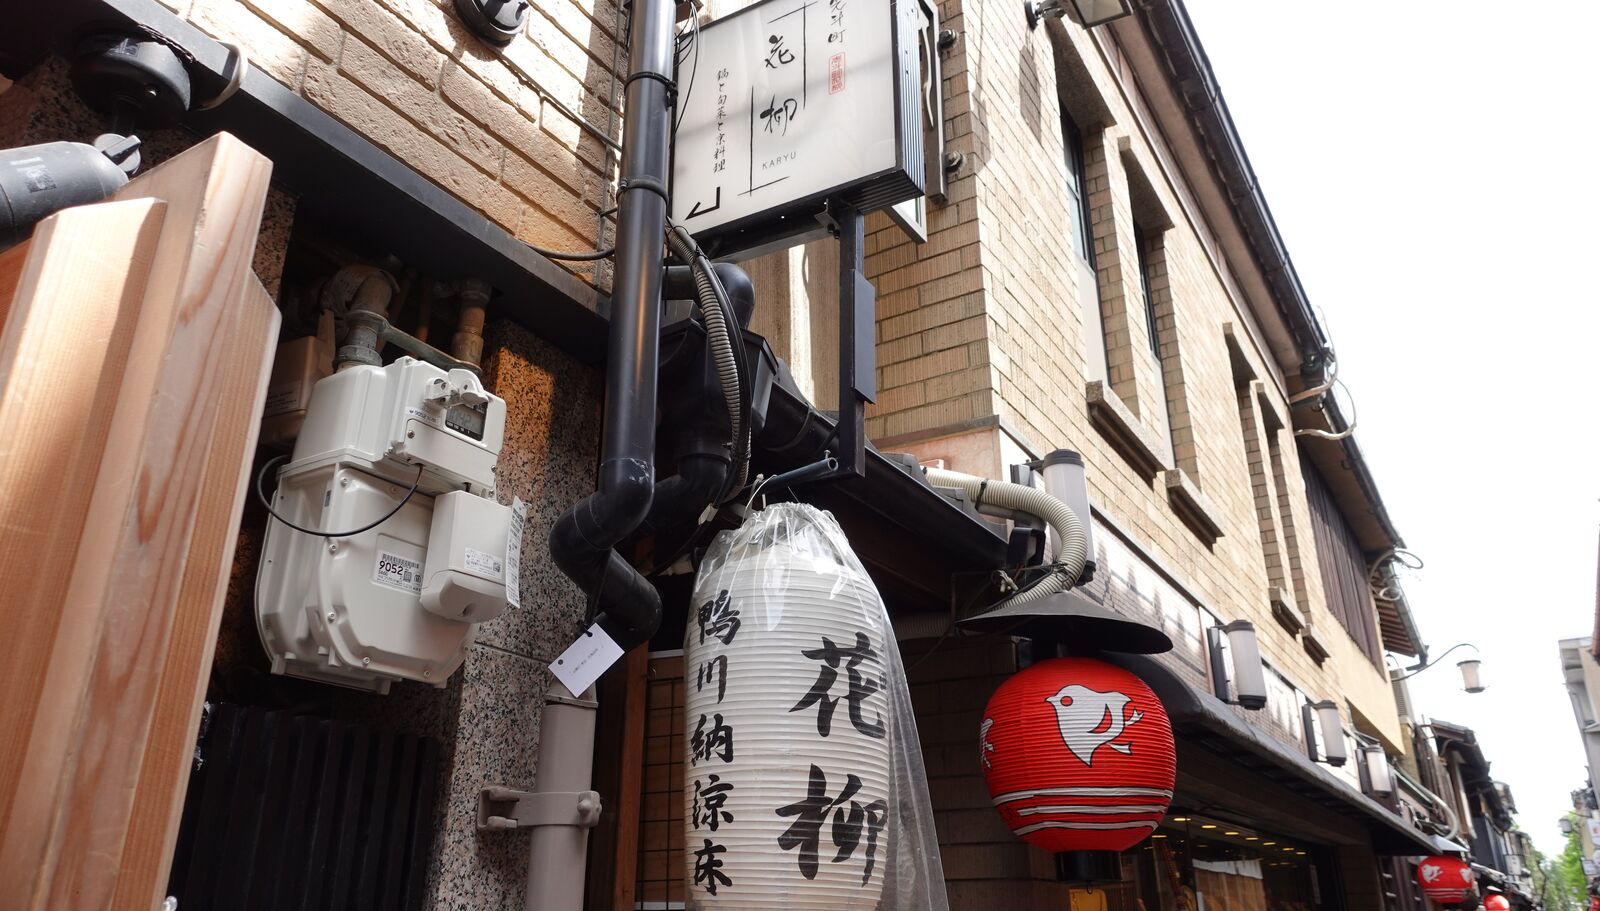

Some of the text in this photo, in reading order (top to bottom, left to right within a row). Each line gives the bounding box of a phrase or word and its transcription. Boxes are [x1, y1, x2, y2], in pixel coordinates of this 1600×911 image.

[713, 68, 729, 173] 鍋と旬菜と京料理
[760, 34, 797, 136] 花柳
[762, 152, 797, 170] KARYU
[379, 560, 404, 576] 9052
[690, 589, 741, 896] 鴨川納涼床
[775, 631, 889, 888] 花柳
